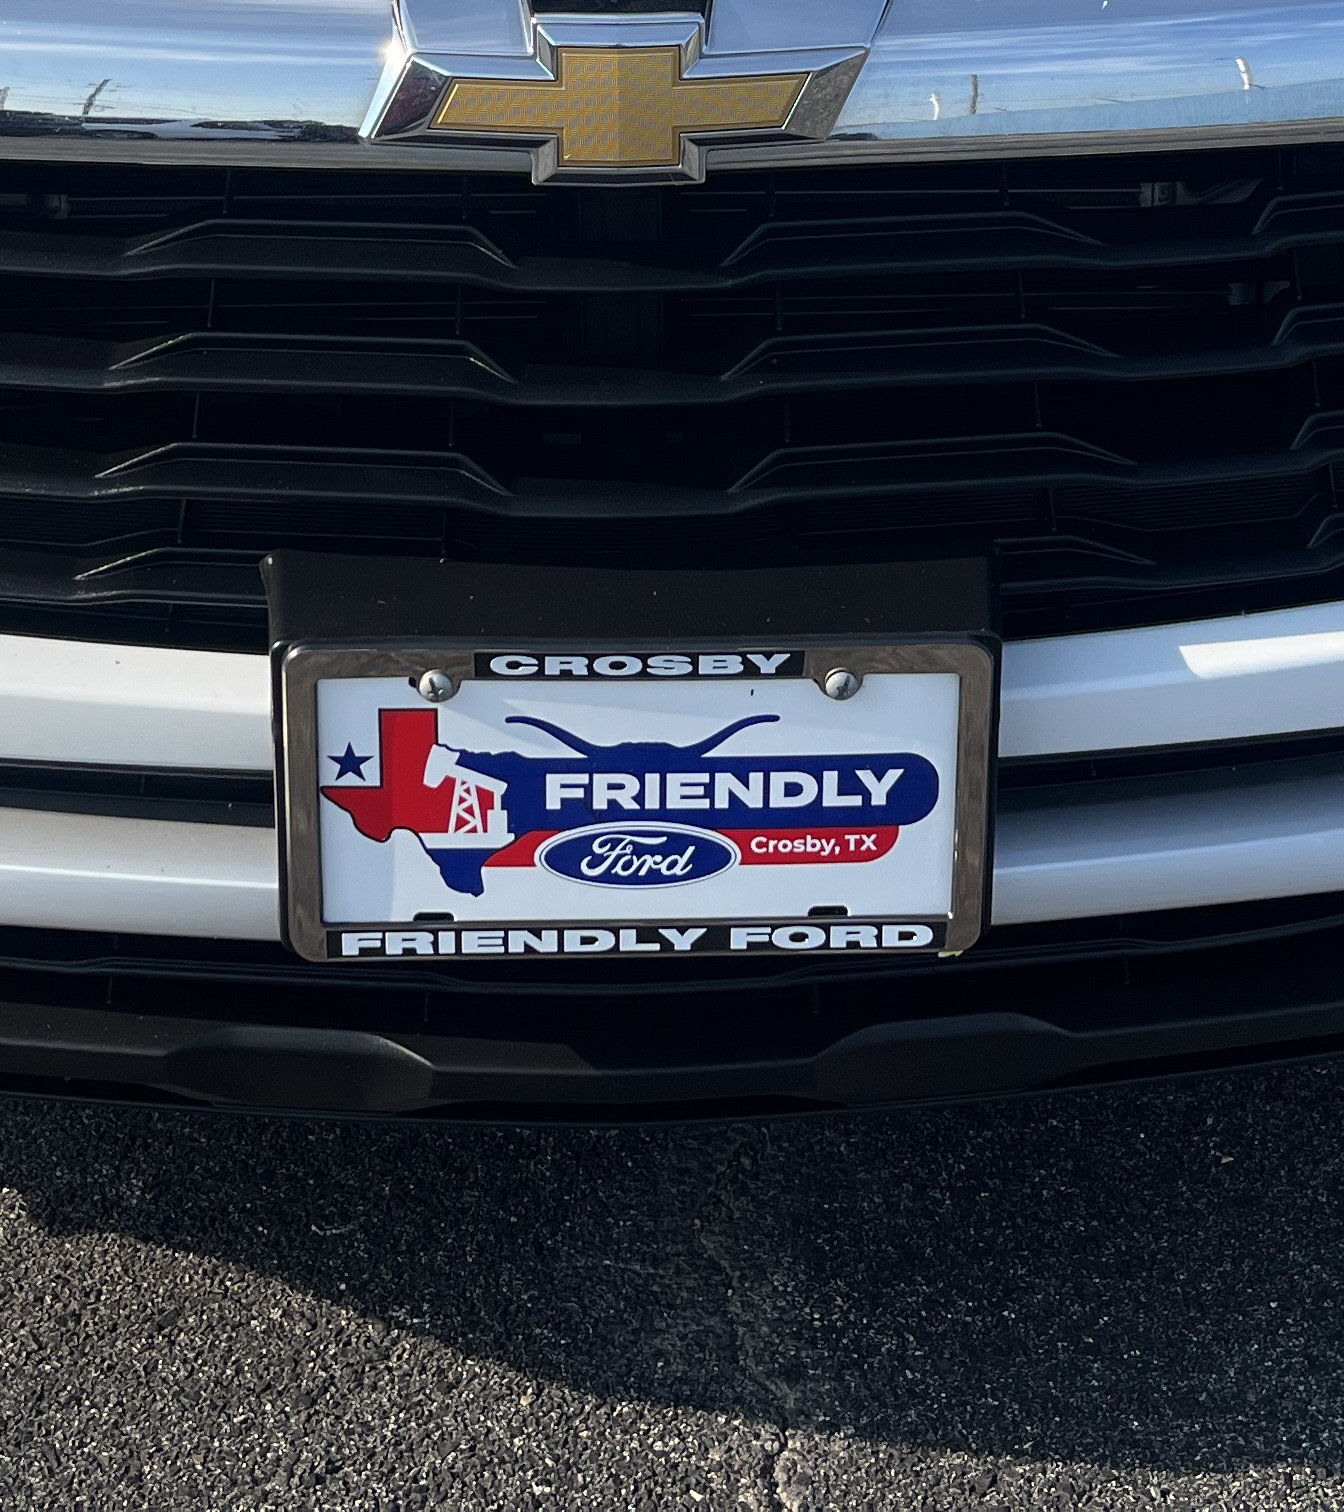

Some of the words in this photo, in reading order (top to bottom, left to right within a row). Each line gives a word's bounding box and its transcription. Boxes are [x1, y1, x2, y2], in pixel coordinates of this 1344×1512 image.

[489, 654, 792, 676] CROSBY
[545, 769, 904, 811] FRIENDLY
[580, 834, 694, 880] Ford
[750, 834, 840, 857] Crosby,
[844, 834, 878, 853] TX
[341, 928, 708, 956] FRIENDLY
[730, 924, 934, 951] FORD
